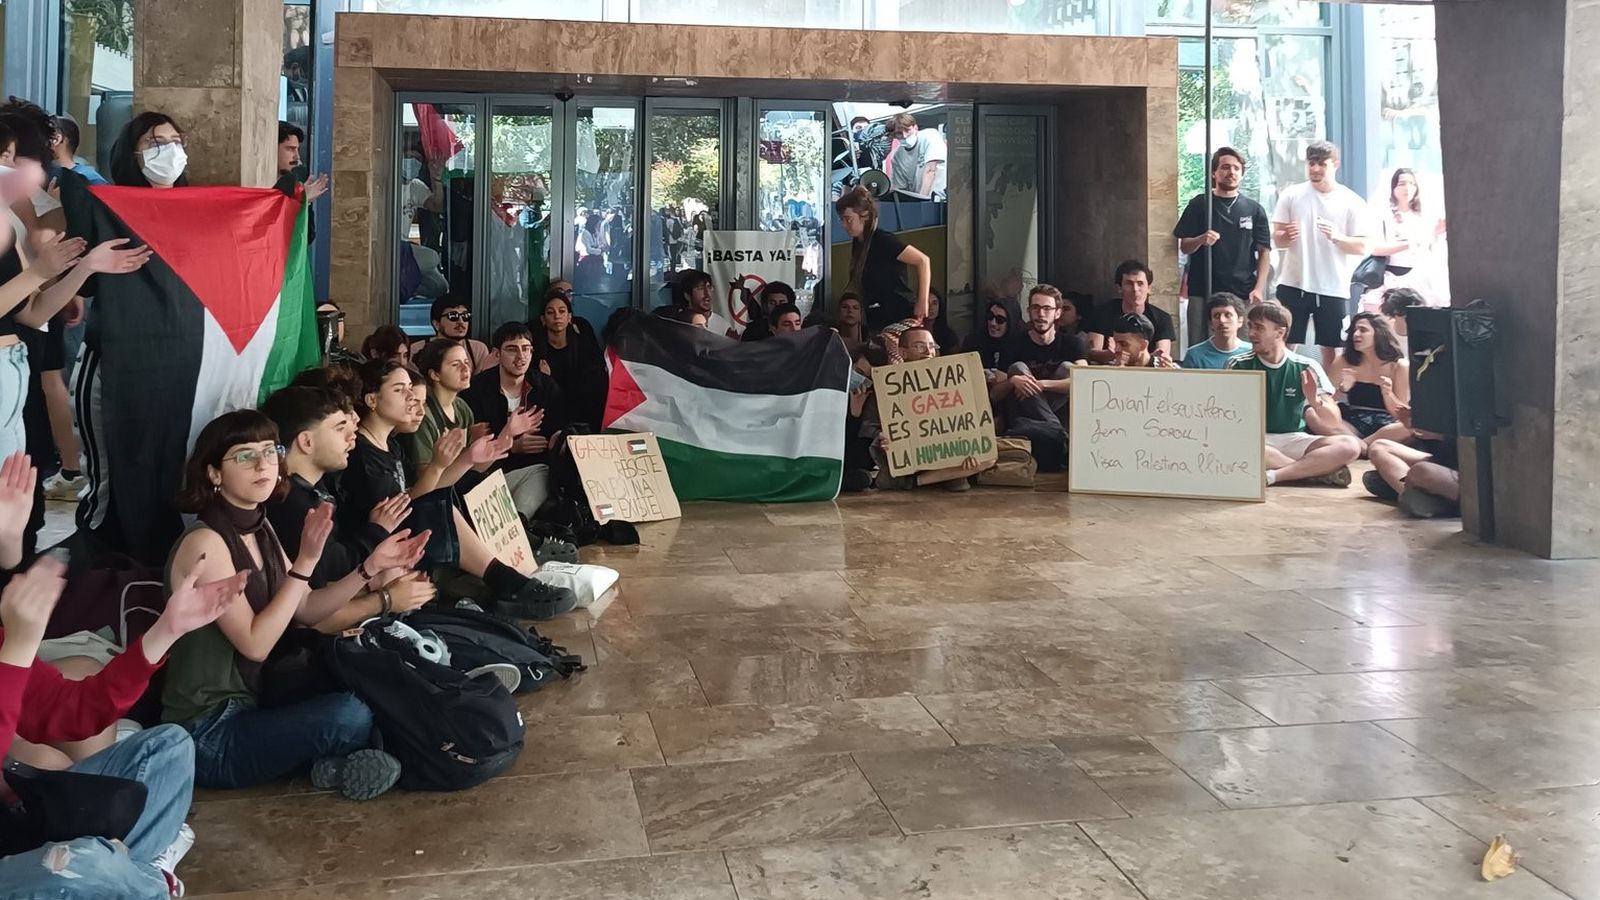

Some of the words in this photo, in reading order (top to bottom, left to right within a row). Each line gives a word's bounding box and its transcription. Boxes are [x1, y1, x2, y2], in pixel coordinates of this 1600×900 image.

[707, 250, 764, 264] ¡BASTA
[769, 250, 792, 262] YA!
[885, 363, 967, 396] SALVAR
[891, 402, 904, 419] A
[911, 389, 964, 415] GAZA
[888, 420, 911, 442] ES
[919, 411, 976, 438] SALVAR
[979, 410, 992, 427] A
[891, 449, 911, 470] LA
